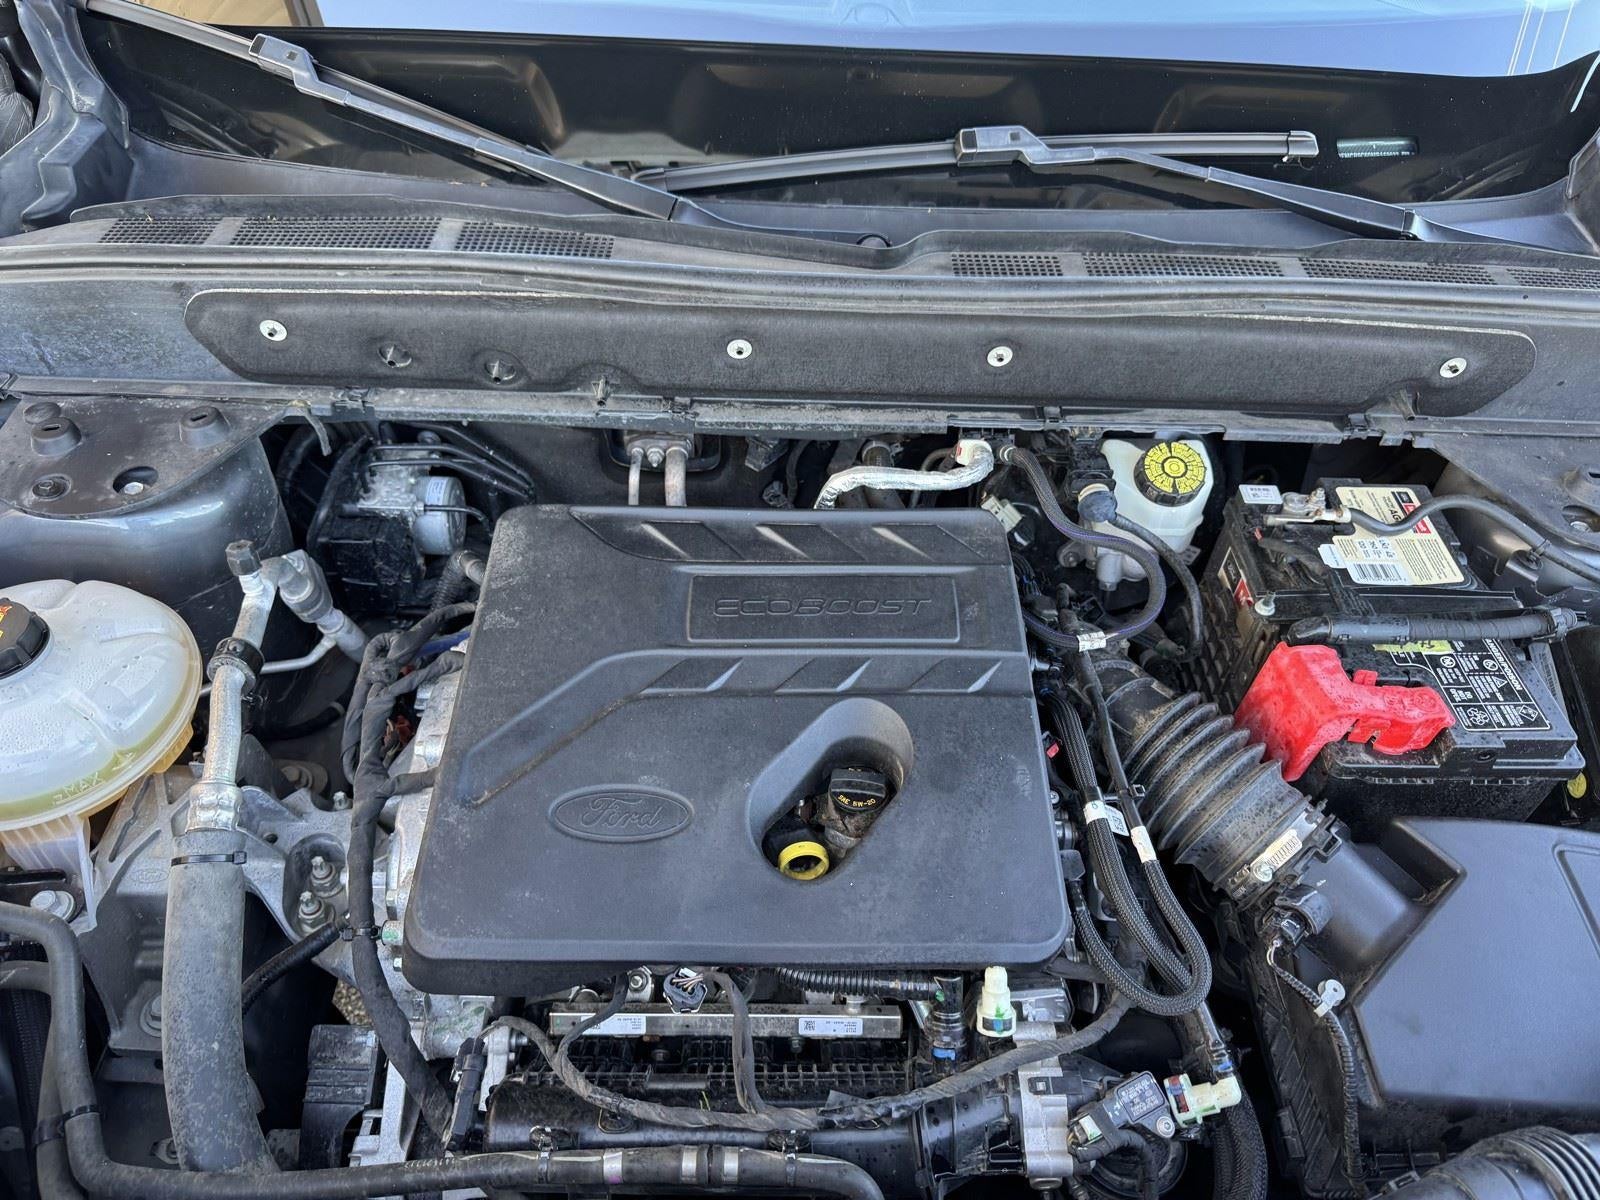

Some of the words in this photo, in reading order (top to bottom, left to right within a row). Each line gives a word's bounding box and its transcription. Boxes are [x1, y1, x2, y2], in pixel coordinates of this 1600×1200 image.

[713, 598, 932, 617] ECOBOOST
[1485, 639, 1523, 690] ANGER/POISON
[64, 771, 102, 797] MAX
[580, 796, 663, 829] Ford
[837, 794, 851, 805] SAE
